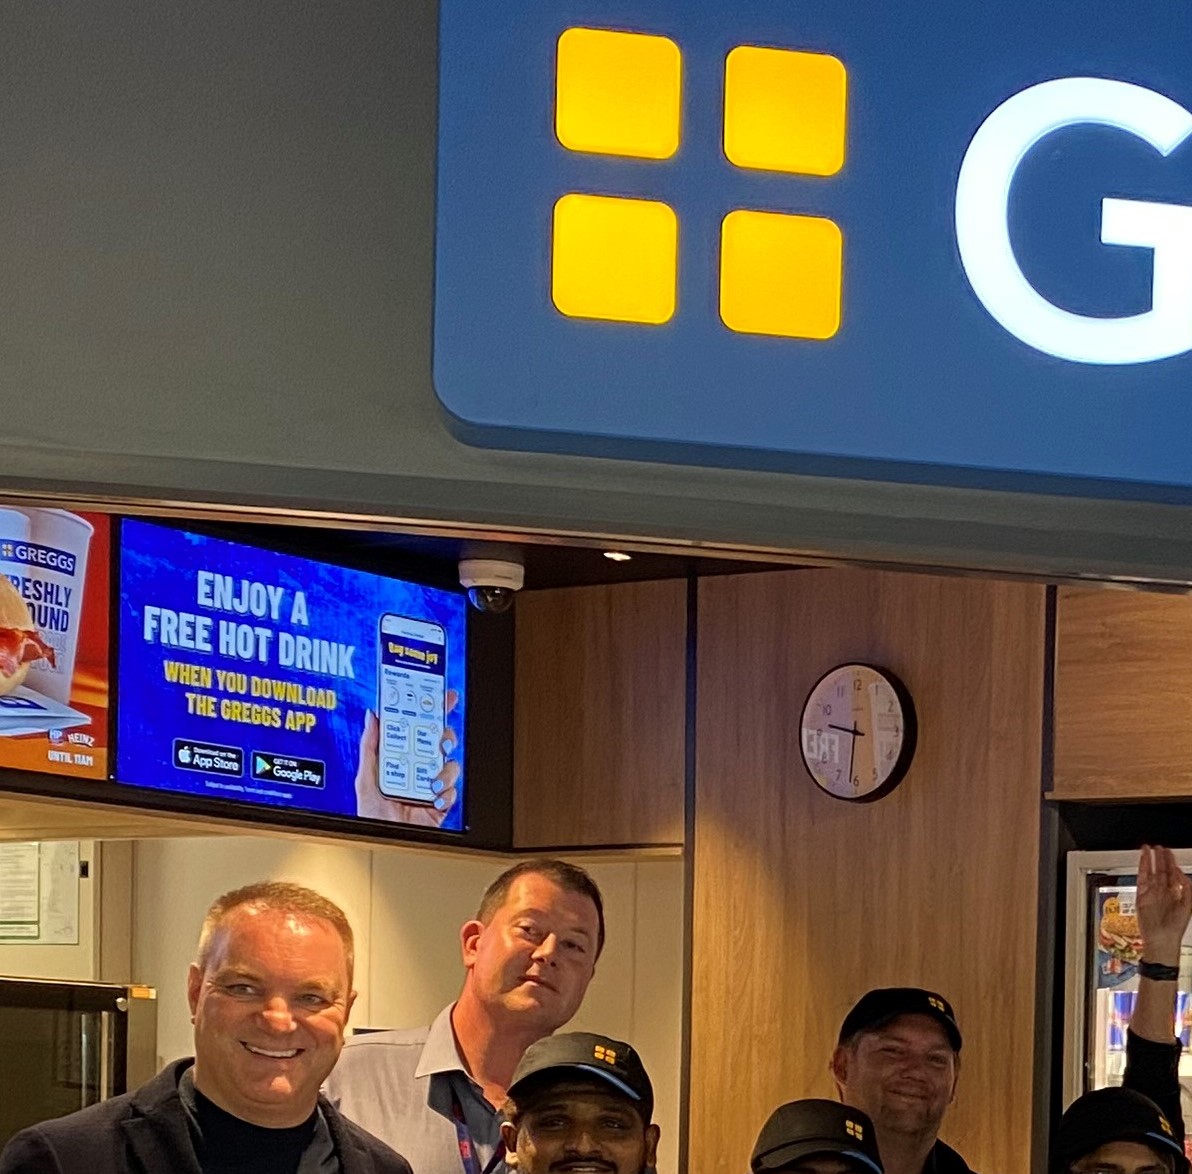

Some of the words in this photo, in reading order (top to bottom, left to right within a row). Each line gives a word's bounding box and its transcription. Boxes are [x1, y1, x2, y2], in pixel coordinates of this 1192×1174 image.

[15, 545, 74, 571] GREGGS
[197, 570, 284, 620] ENJOY
[291, 591, 308, 626] A
[144, 605, 213, 651] FREE
[219, 620, 272, 662] HOT
[278, 631, 356, 679] DRINK
[163, 660, 212, 688] WHEN
[217, 670, 247, 694] YOU
[251, 675, 337, 710] DOWNLOAD
[185, 692, 217, 718] THE
[221, 699, 281, 728] GREGGS
[285, 710, 316, 732] APP
[68, 733, 95, 746] HEINZ
[193, 755, 212, 768] App
[213, 757, 239, 771] Store
[273, 766, 303, 781] Google
[303, 770, 321, 784] Play
